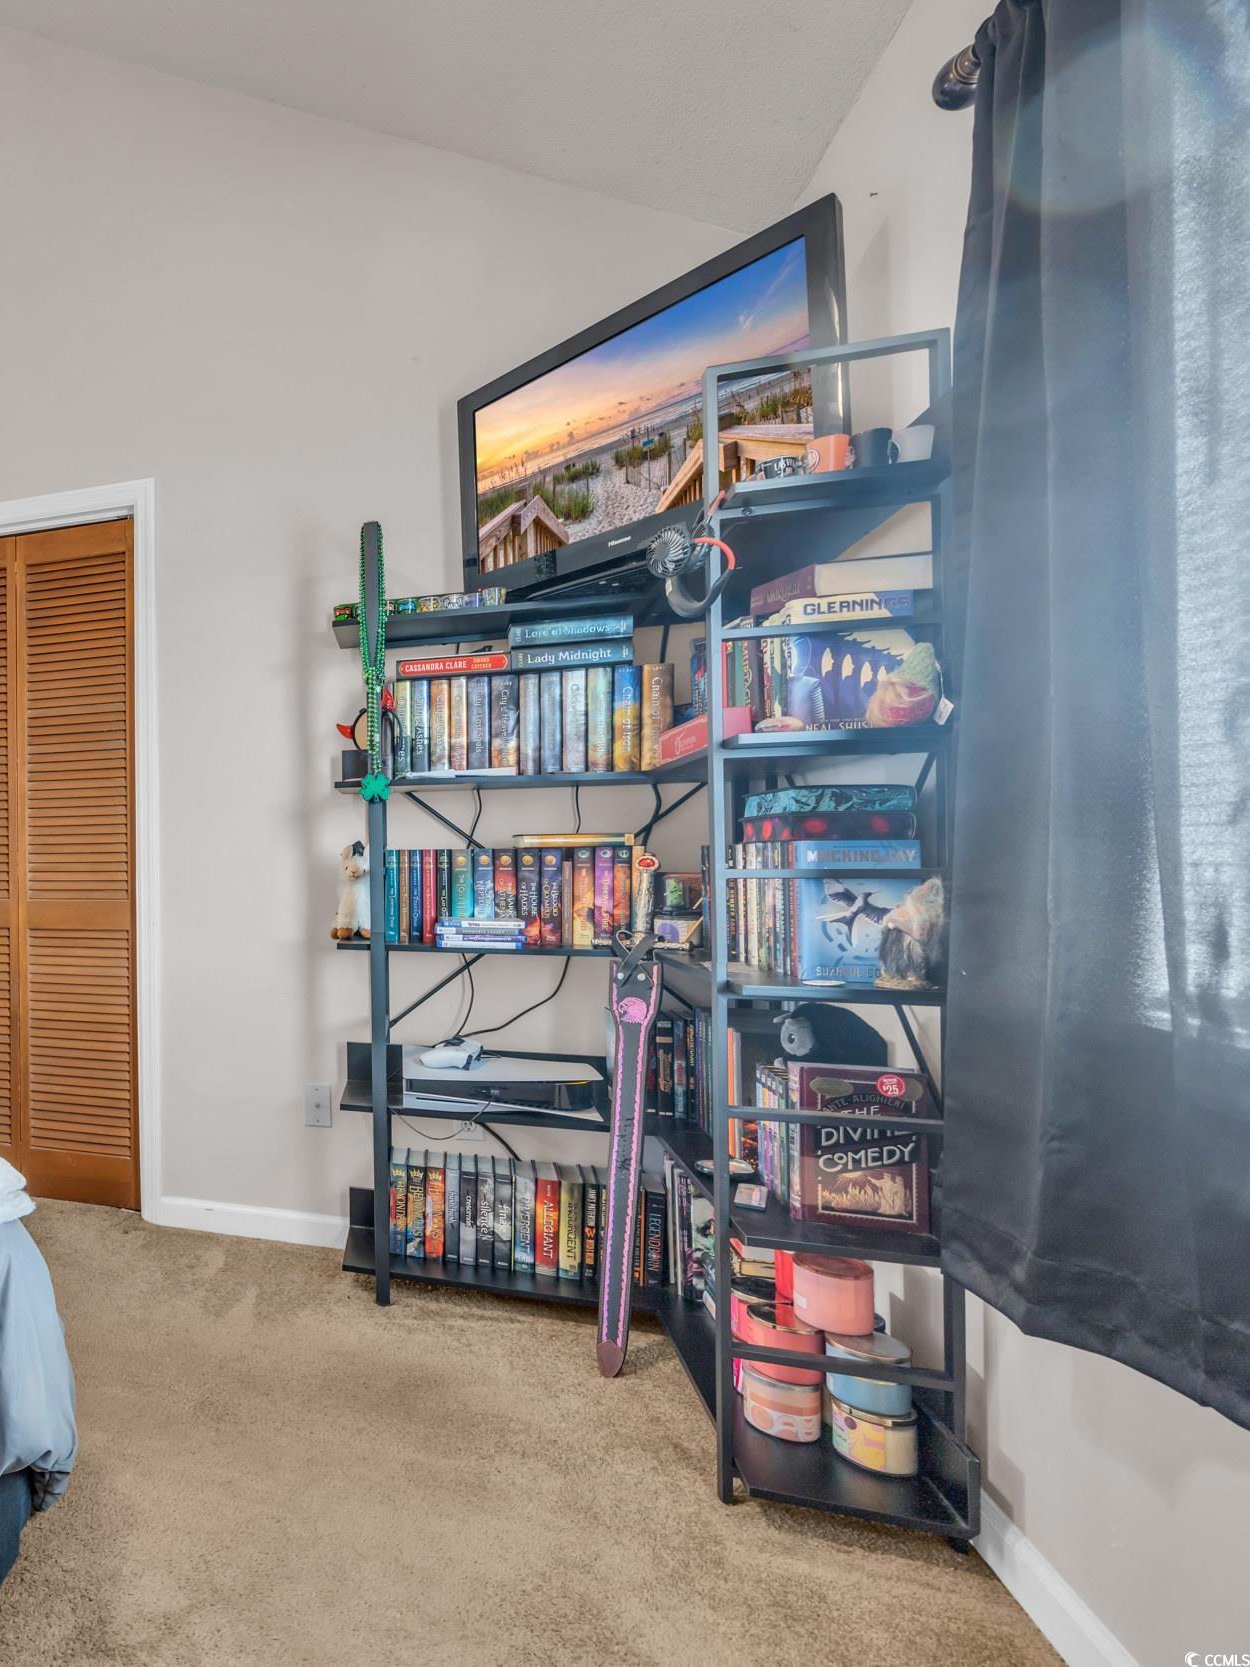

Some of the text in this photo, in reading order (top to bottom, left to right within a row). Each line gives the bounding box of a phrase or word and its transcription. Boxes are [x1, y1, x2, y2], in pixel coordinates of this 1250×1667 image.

[803, 595, 911, 616] GLEANINGS
[405, 660, 467, 673] CASSANDRA CLARE
[527, 648, 612, 665] Lady Midnight
[622, 686, 633, 714] Chain
[651, 676, 663, 706] Chain
[519, 889, 528, 916] HADES
[529, 890, 538, 916] HOUSE
[822, 1097, 849, 1112] ANTE
[882, 1084, 900, 1096] $25
[840, 1105, 881, 1117] THE
[818, 1142, 916, 1173] COMEDY
[409, 1185, 424, 1237] BEYONDERS
[480, 1200, 492, 1233] silence
[498, 1203, 510, 1233] finale
[519, 1197, 531, 1255] DIVERGENT
[542, 1200, 554, 1259] ALLEGIANT
[566, 1202, 577, 1261] INSURGENT
[647, 1212, 662, 1272] LEGENDBORN
